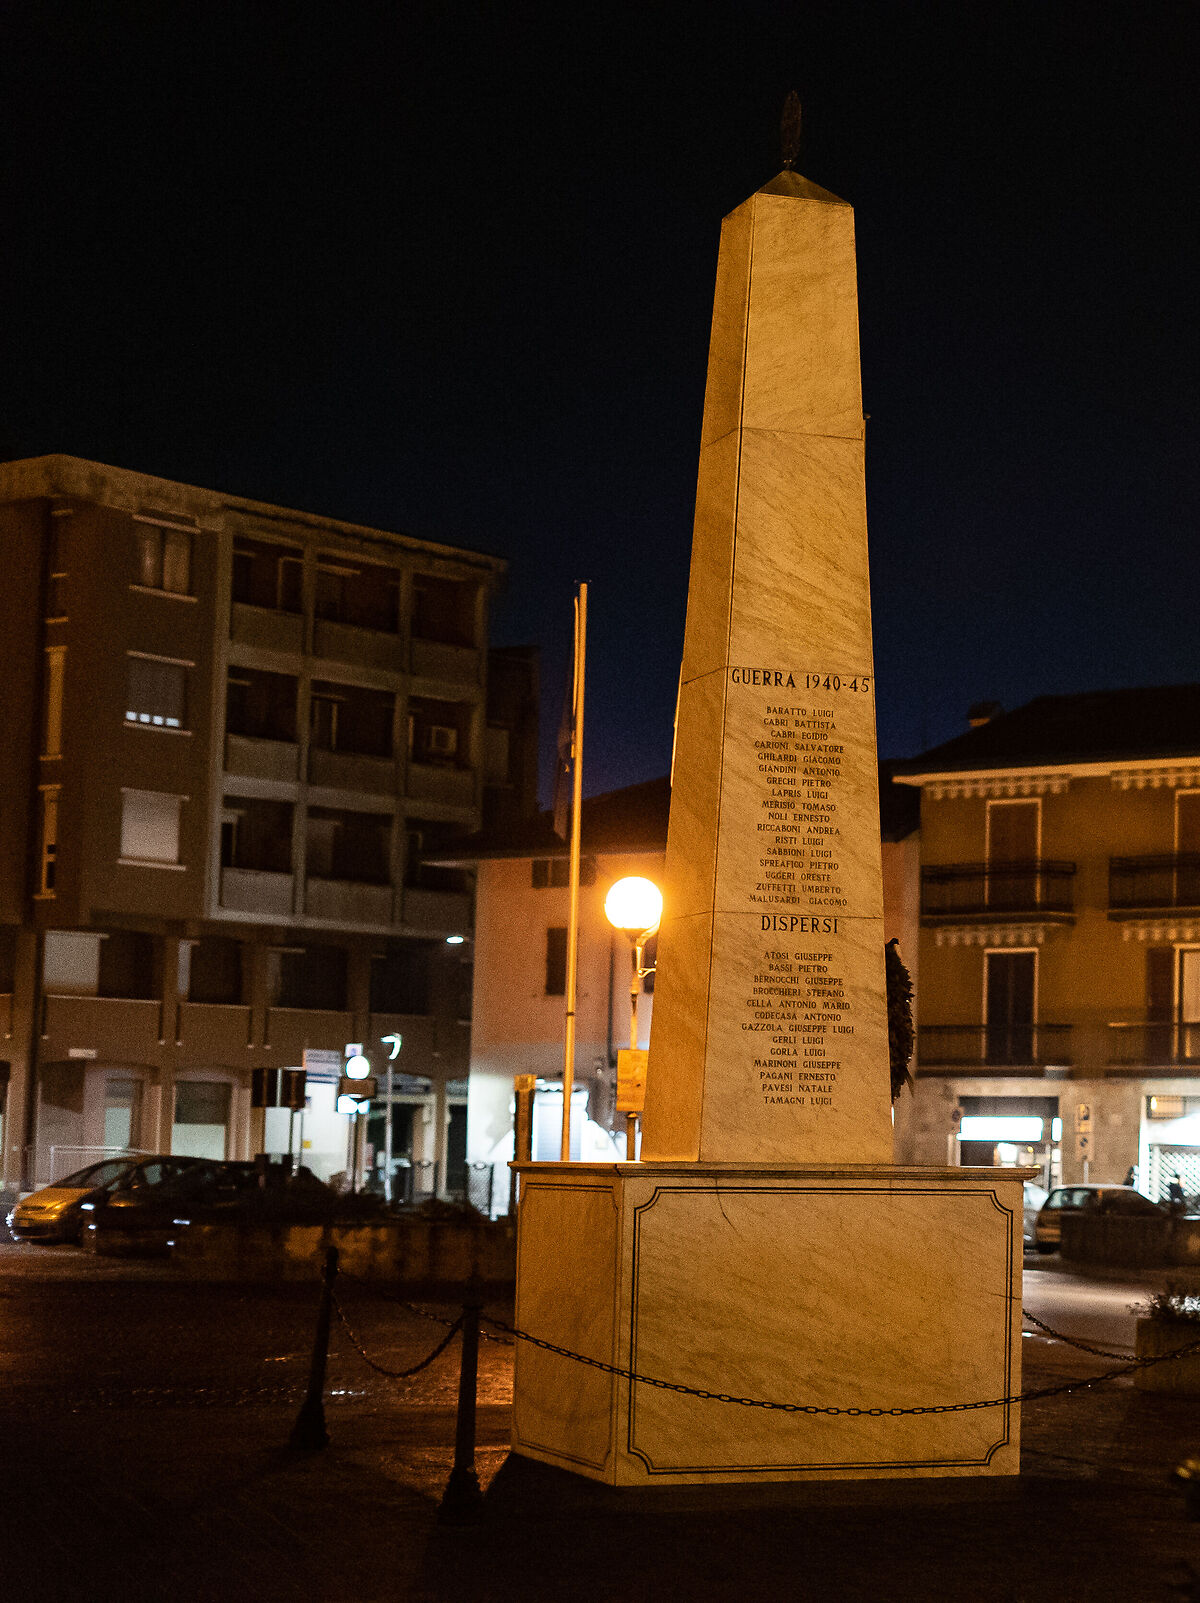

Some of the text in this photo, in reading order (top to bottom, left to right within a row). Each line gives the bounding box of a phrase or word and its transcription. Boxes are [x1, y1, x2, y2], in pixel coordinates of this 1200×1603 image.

[731, 668, 871, 693] GUERRA 1940-45
[766, 706, 834, 718] BARATTO LUIGI
[794, 719, 837, 730] BATTISTA
[801, 731, 828, 741] EGIDIO
[754, 741, 844, 754] CARIONI SALVATORE
[757, 752, 841, 765] GHILARDI GIACOMO
[758, 764, 840, 777] GIANDINI ANTONIO
[766, 777, 832, 788] GRECHI PIETRO
[771, 788, 828, 799] LAPRIS LUIGI
[762, 800, 836, 812] MERISIO TOMASO
[768, 812, 830, 823] NOLI ERNESTO
[757, 823, 840, 835] RICCABONI ANDREA
[775, 836, 824, 846] RISTI LUIGI
[766, 848, 832, 858] SABBIONI LUIGI
[759, 859, 839, 870] SPREAFICO PIETRO
[765, 871, 831, 882] UGGERI ORESTE
[756, 883, 841, 894] ZUFFETTI UMBERTO
[748, 895, 848, 906] MALUSARDI GIACOMO
[761, 915, 839, 934] DISPERSI
[794, 952, 833, 962] GIUSEPPE
[768, 963, 828, 973] BASSI PIETRO
[754, 975, 843, 986] BERNOCCHI GIUSEPPE
[753, 987, 845, 997] BROCCHIERI STEFANO
[746, 1000, 851, 1010] CELLA ANTONIO MARIO
[754, 1012, 842, 1022] CODECASA ANTONIO
[741, 1023, 854, 1034] GAZZOLA GIUSEPPE LUIGI
[772, 1036, 824, 1045] GERLI LUIGI
[770, 1047, 826, 1057] GORLA LUIGI
[753, 1059, 842, 1070] MARINONI GIUSEPPE
[760, 1071, 836, 1081] PAGANI ERNESTO
[762, 1083, 833, 1093] PAVESI NATALE
[763, 1096, 832, 1106] TAMAGNI LUIGI
